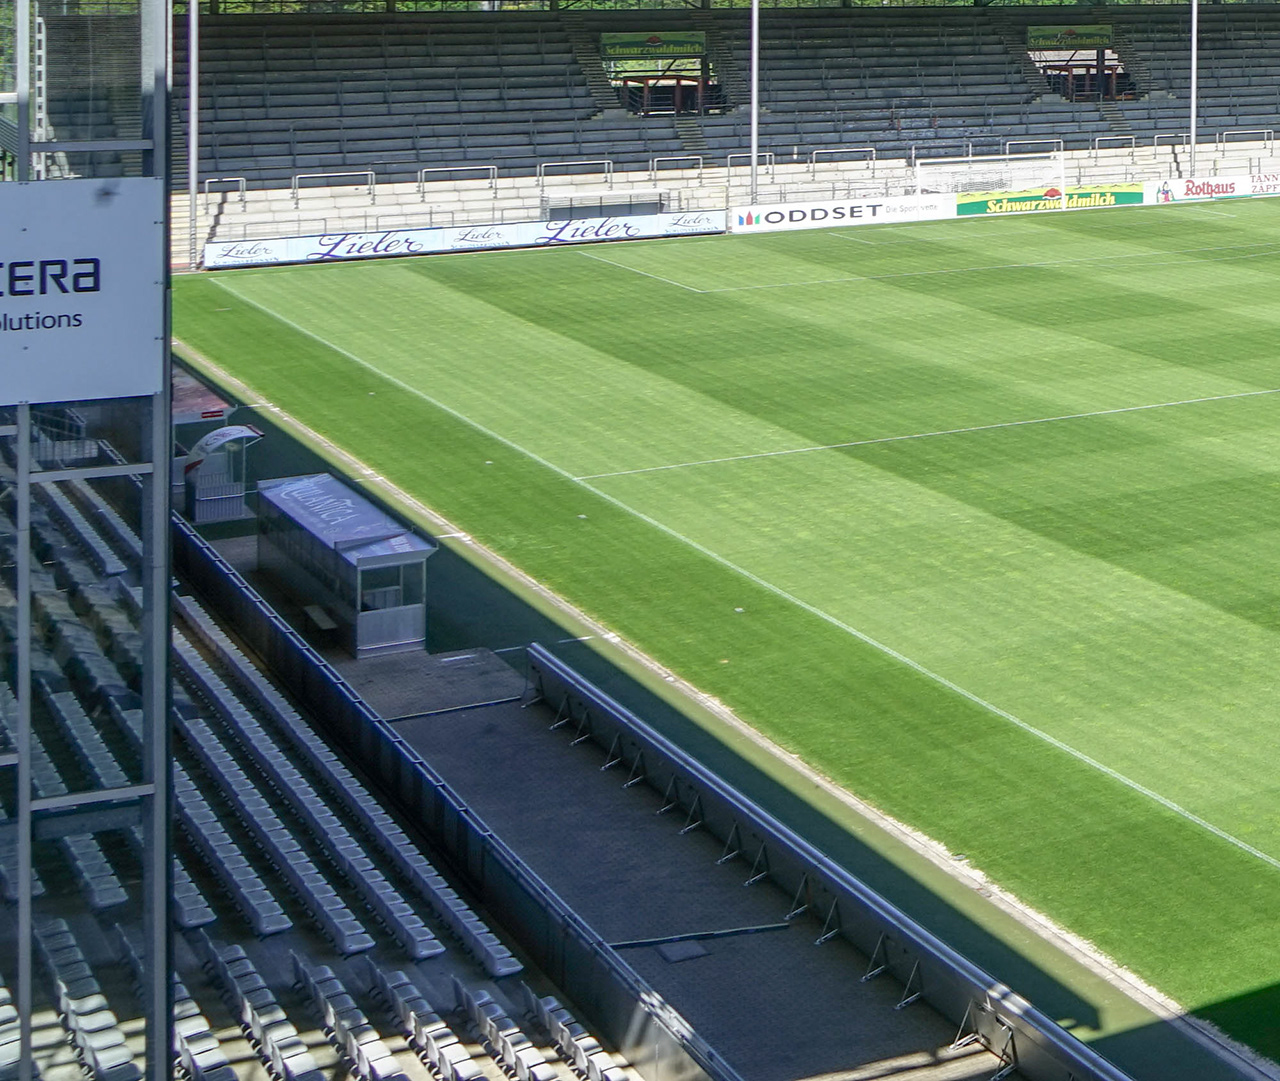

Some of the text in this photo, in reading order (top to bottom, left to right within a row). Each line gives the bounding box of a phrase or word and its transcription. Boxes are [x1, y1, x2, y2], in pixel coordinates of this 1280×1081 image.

[606, 44, 703, 55] Schwarzwaldmilch
[1184, 179, 1236, 199] Rothaus
[986, 193, 1116, 214] Schwarzwaldmilch
[764, 204, 884, 224] ODDSET
[0, 311, 83, 332] lutions
